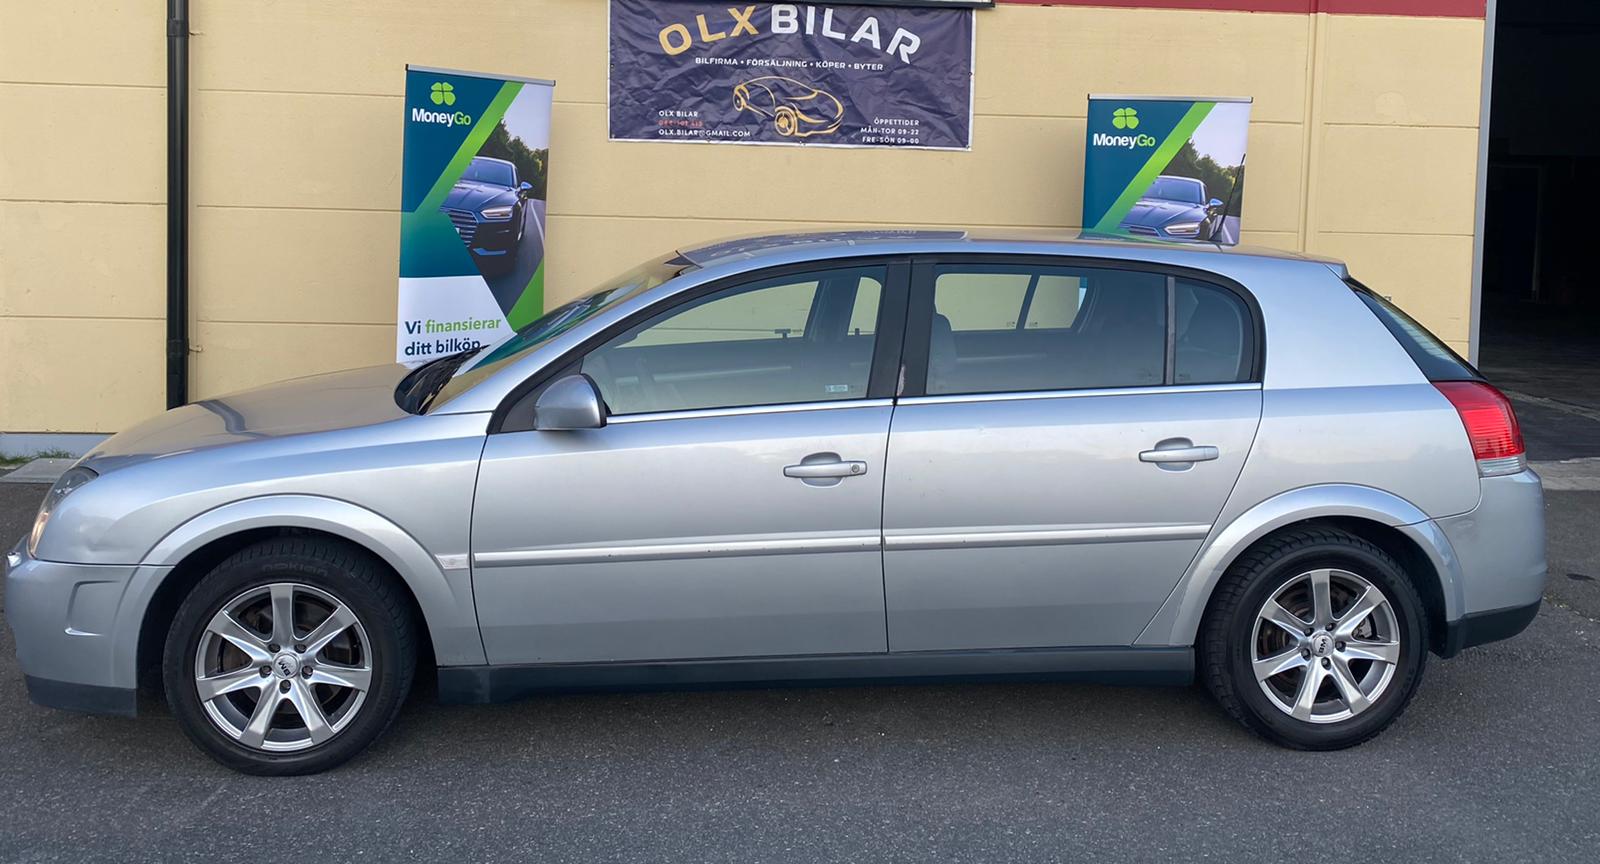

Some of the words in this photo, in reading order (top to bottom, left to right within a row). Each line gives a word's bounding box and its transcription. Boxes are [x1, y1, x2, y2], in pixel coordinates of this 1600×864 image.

[658, 4, 760, 56] OLX
[770, 4, 921, 64] BILAR
[695, 57, 738, 66] BILFIRMA
[746, 58, 807, 68] FÖRSÄLJNING
[816, 60, 846, 69] KÖPER
[854, 62, 884, 71] BYTER
[412, 107, 472, 127] MoneyGo
[676, 110, 698, 118] BILAR
[873, 117, 919, 126] ÖPPETTIDER
[1093, 133, 1156, 149] MoneyGo
[405, 320, 421, 335] Vi
[425, 317, 501, 334] finansierar
[405, 341, 432, 356] ditt
